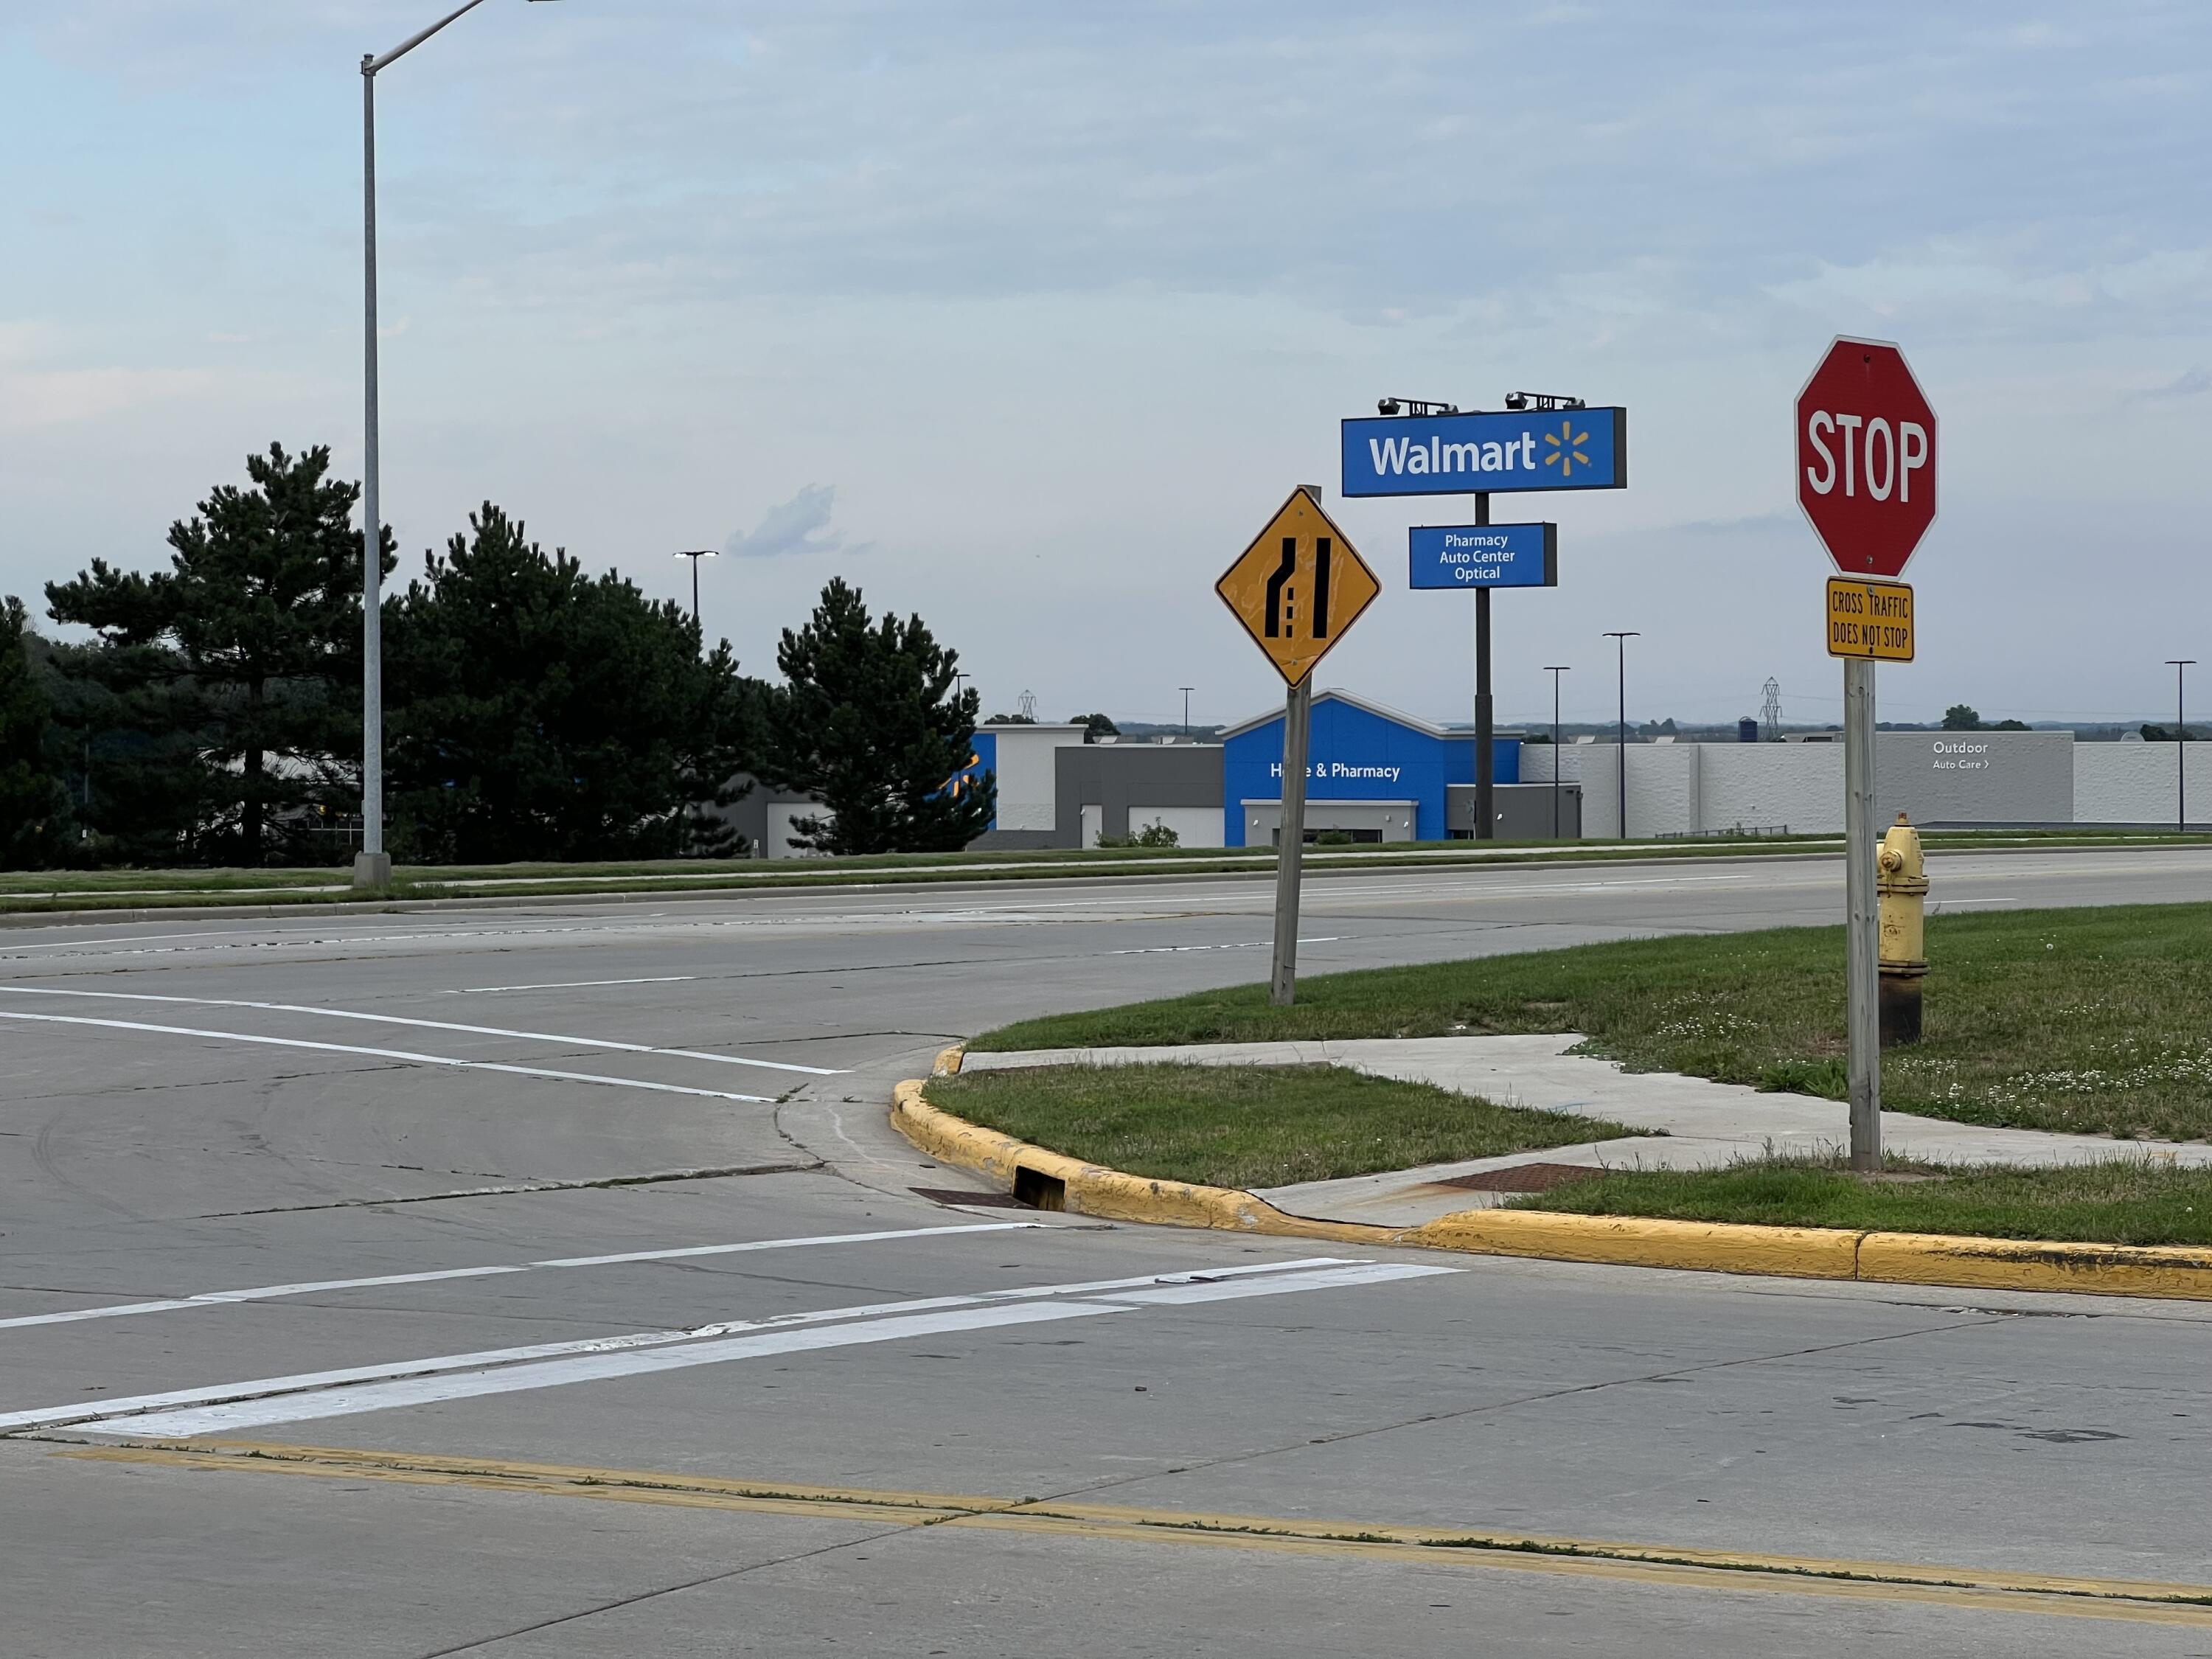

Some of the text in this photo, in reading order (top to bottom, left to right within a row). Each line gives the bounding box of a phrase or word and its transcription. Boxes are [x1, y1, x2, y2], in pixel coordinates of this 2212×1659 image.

[1369, 431, 1536, 476] Walmart
[1807, 410, 1928, 503] STOP
[1445, 534, 1509, 549] Pharmacy
[1439, 550, 1515, 564] Auto Center
[1455, 566, 1500, 582] Optical
[1832, 591, 1908, 619] CROSS TRAFFIC
[1833, 622, 1907, 649] DOES NOT STOP
[1933, 741, 1989, 754] Outdoor
[1270, 762, 1401, 782] He & Pharmacy
[1933, 759, 1981, 769] Auto Care
